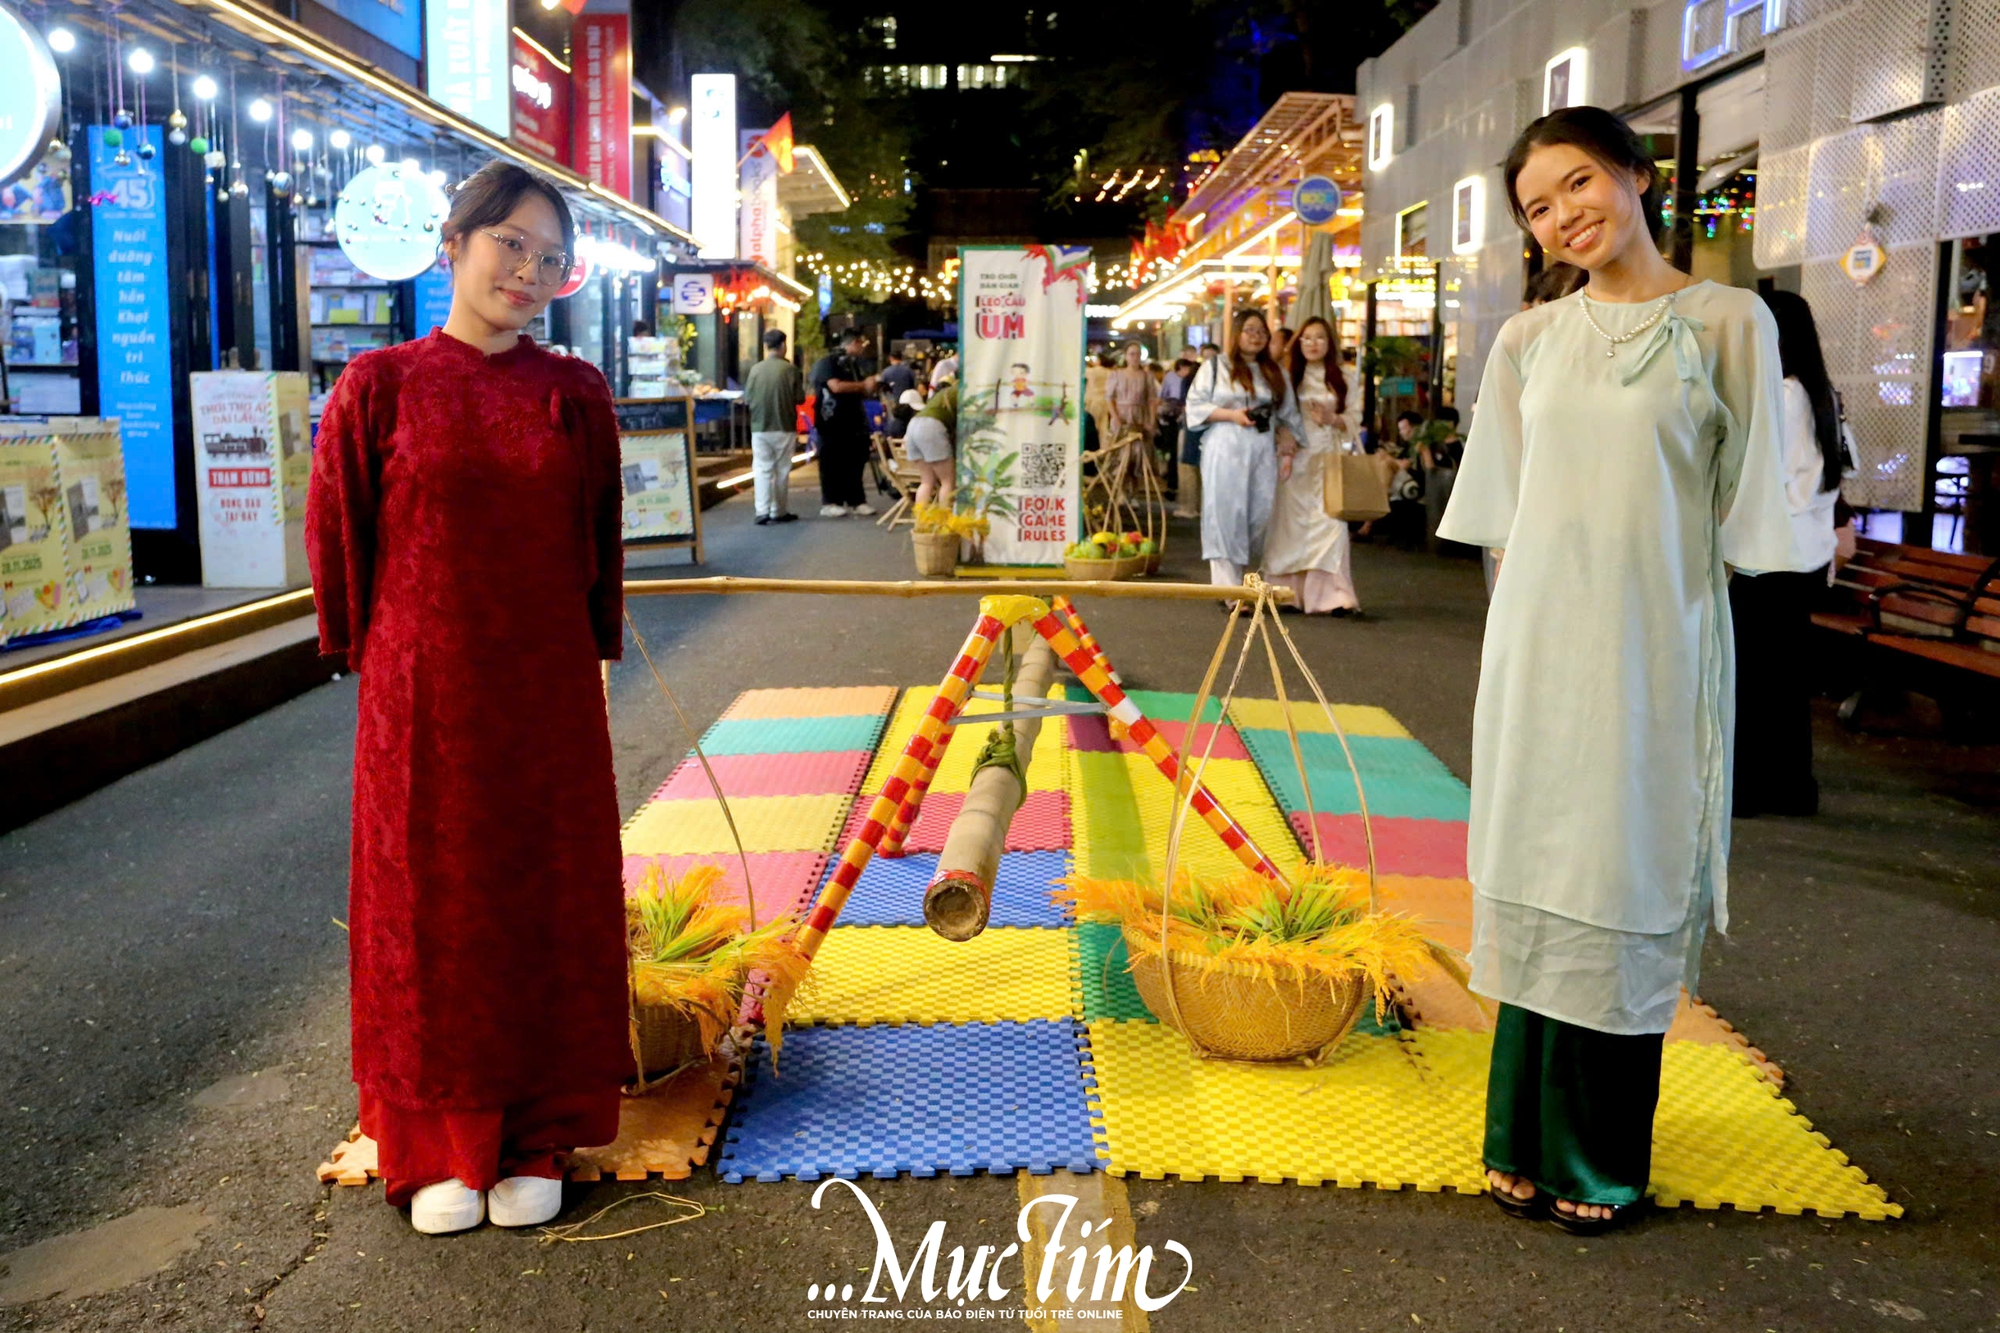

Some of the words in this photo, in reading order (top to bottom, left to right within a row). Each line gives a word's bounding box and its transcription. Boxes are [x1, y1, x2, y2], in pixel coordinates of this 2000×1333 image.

[112, 179, 148, 209] 45
[1024, 497, 1066, 511] FOLK
[1024, 514, 1066, 527] GAME
[1024, 530, 1066, 542] RULES
